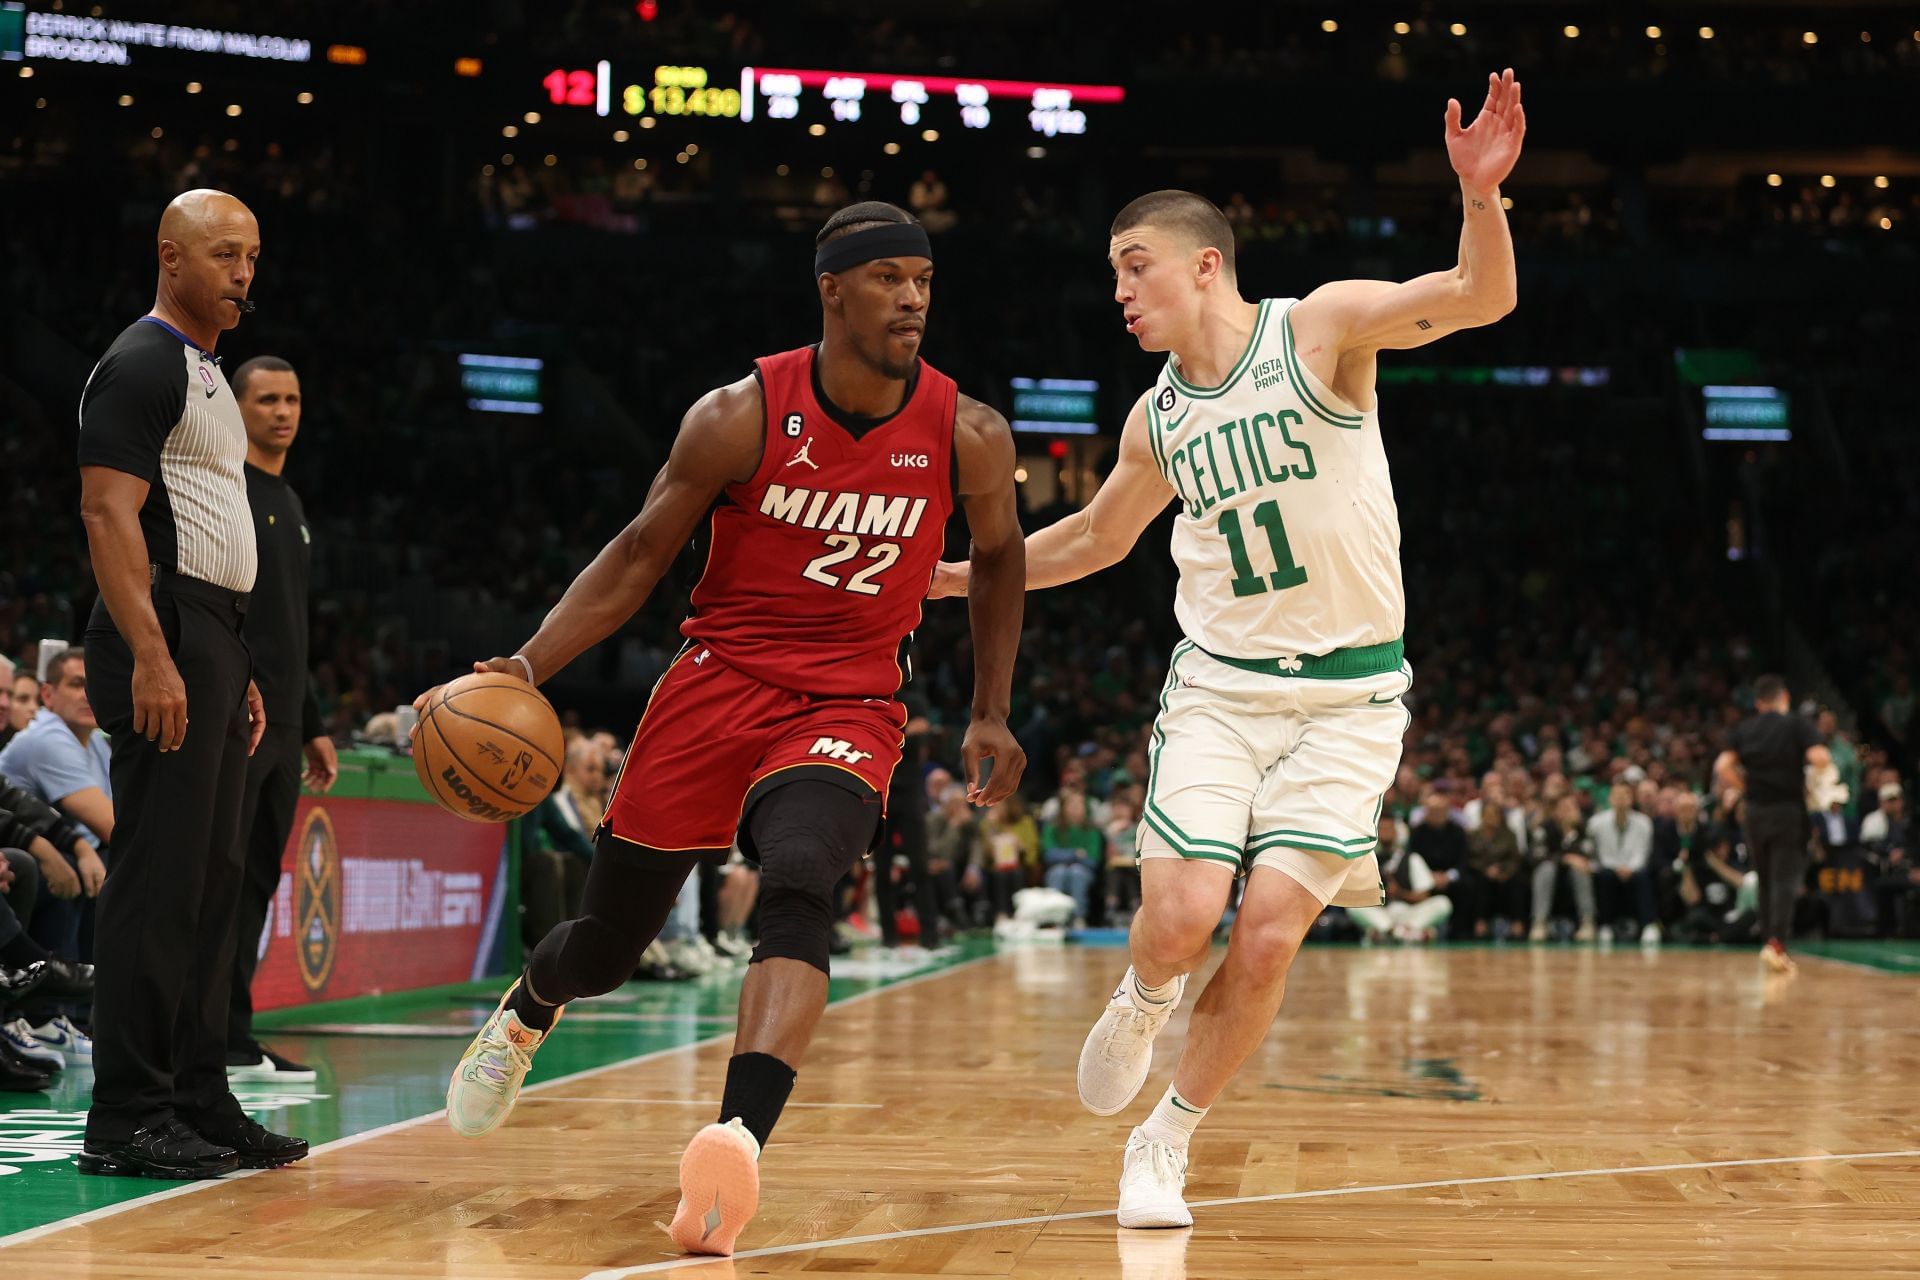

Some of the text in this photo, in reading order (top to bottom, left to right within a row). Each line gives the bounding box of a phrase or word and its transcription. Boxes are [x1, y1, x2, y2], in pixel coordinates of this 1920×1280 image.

[108, 20, 166, 47] WHITE
[167, 26, 223, 53] FROM
[543, 69, 595, 106] 12
[1251, 358, 1284, 380] VISTA
[1254, 371, 1286, 392] PRINT
[1160, 391, 1174, 411] 6
[787, 415, 802, 436] 6
[1171, 409, 1317, 519] CELTICS
[759, 484, 928, 537] MIAMI
[802, 534, 901, 596] 22
[1218, 499, 1308, 597] 11
